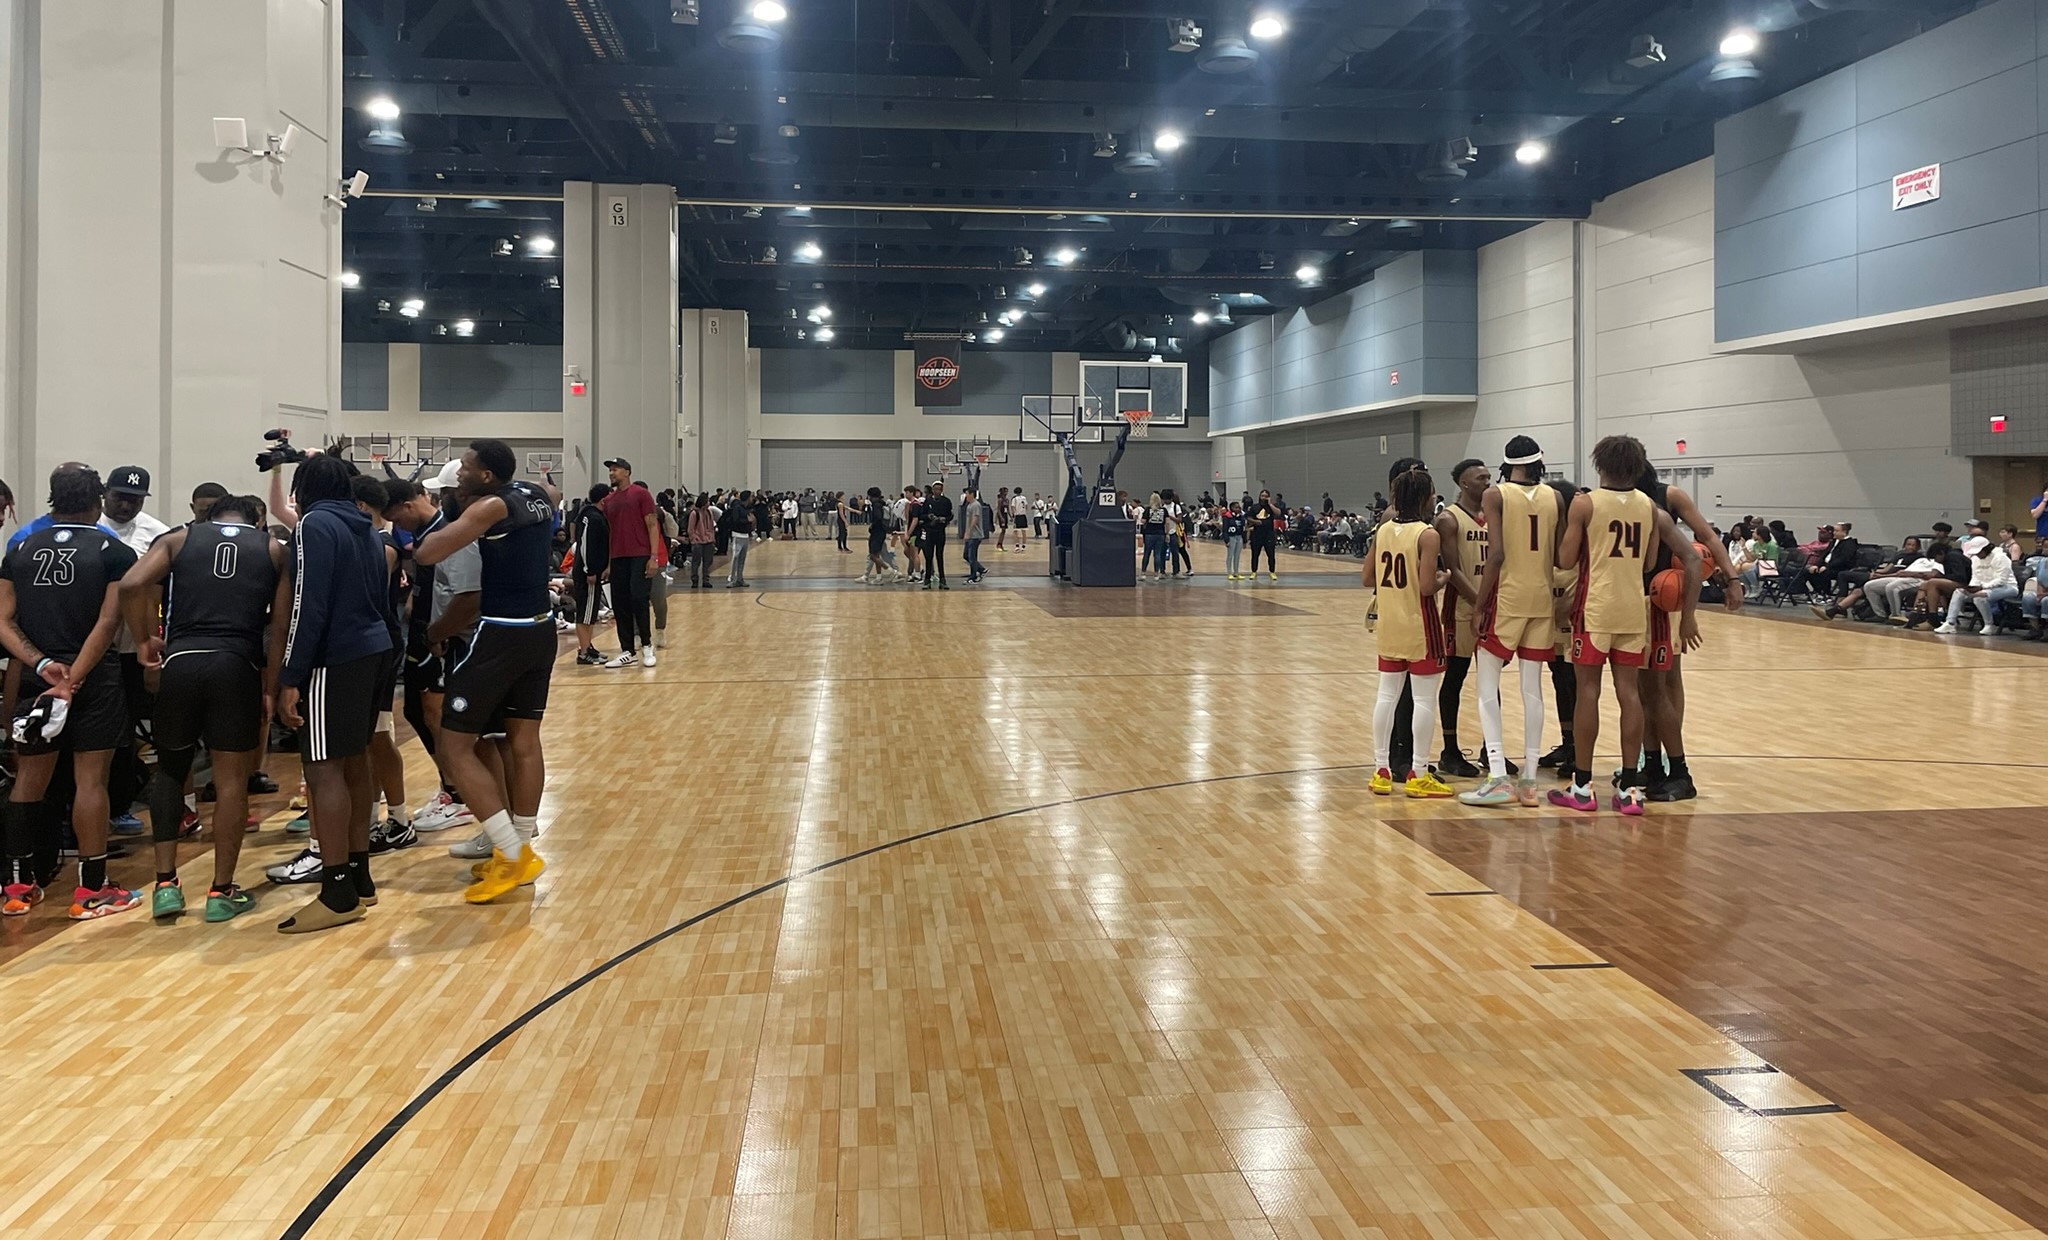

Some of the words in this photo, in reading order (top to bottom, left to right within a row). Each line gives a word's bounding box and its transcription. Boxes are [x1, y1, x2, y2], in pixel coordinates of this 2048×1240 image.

[1896, 167, 1936, 186] EMERGENCY
[1898, 185, 1913, 197] EXIT
[1914, 179, 1933, 191] ONLY
[612, 202, 623, 213] G
[612, 215, 625, 226] 13
[920, 368, 957, 377] HOOPSEEN
[1102, 494, 1113, 503] 12
[1528, 514, 1539, 552] 1
[1608, 519, 1642, 559] 24
[32, 548, 78, 586] 23
[213, 541, 238, 579] 0
[1380, 550, 1408, 589] 20
[1655, 645, 1668, 666] G
